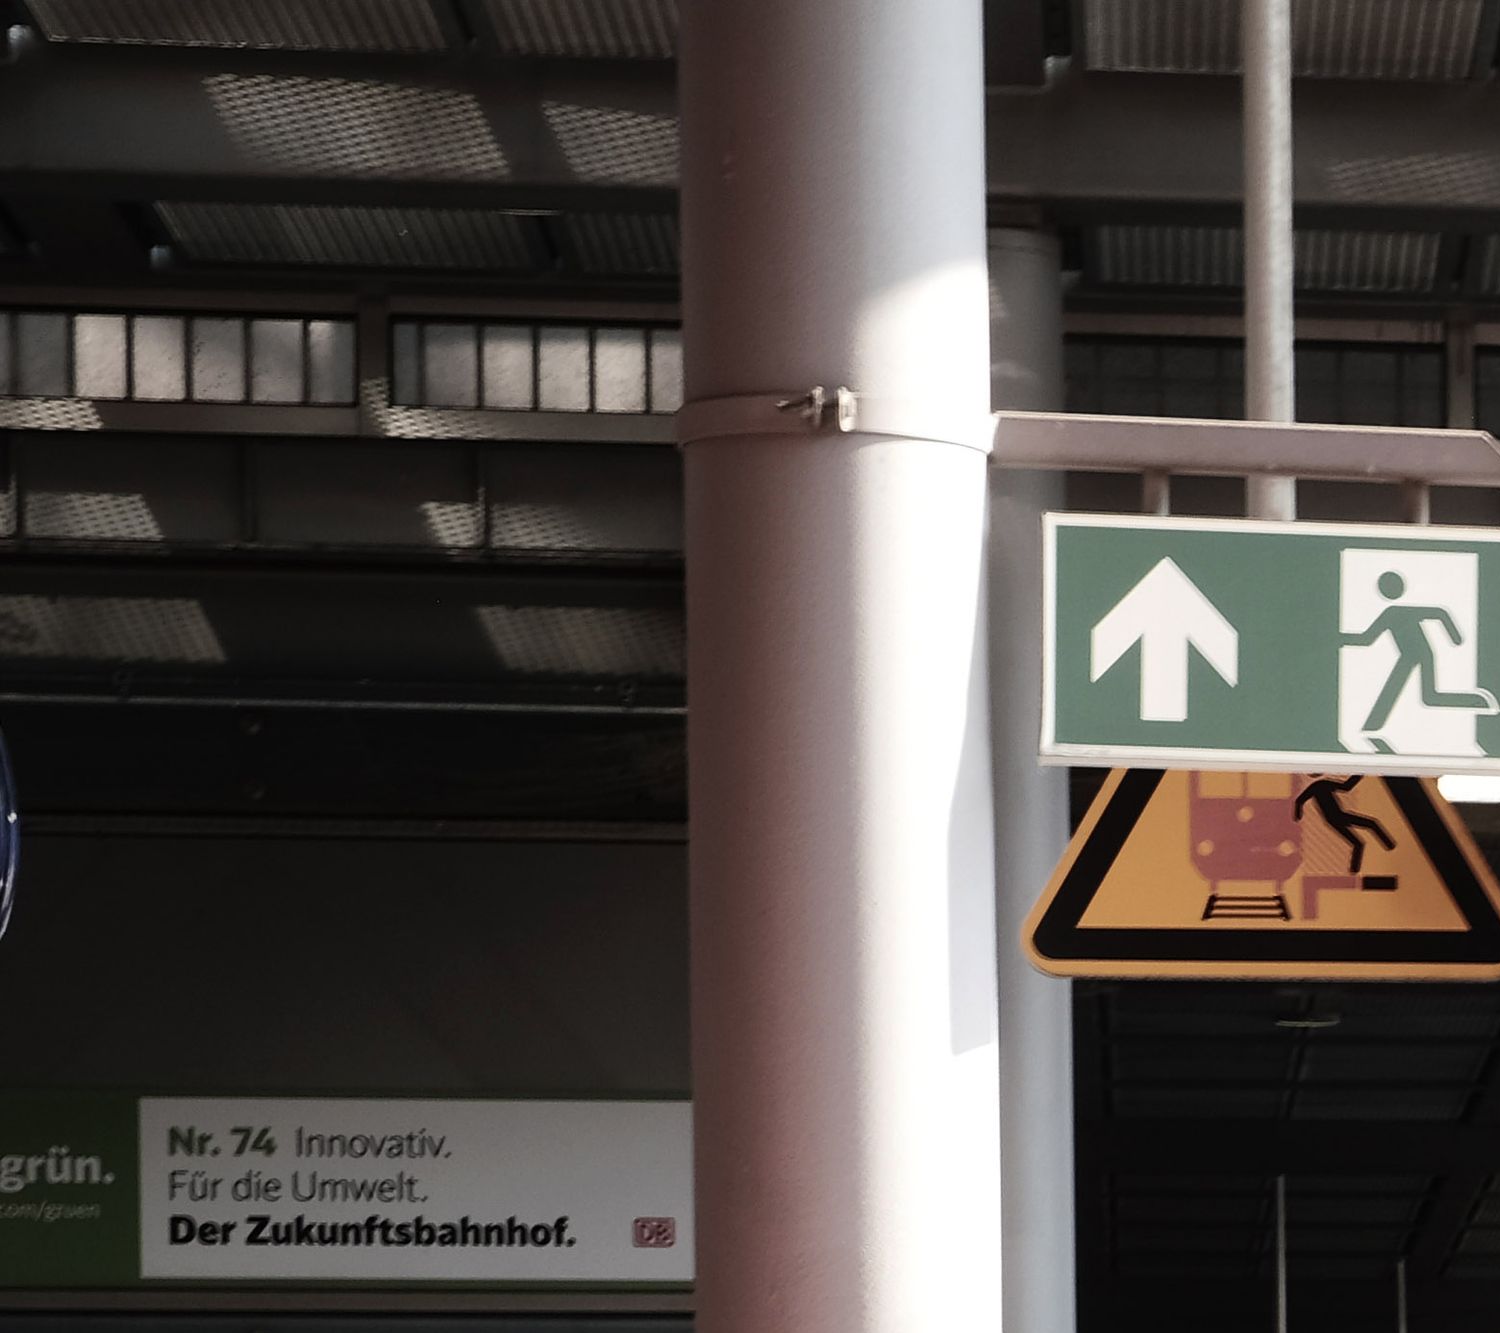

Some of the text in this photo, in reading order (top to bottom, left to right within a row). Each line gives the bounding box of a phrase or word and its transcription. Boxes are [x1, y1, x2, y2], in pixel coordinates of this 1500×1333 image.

[168, 1126, 452, 1159] Nr. 74 Innovativ.
[0, 1145, 115, 1193] grün.
[168, 1170, 429, 1203] Für die Umwelt.
[169, 1215, 577, 1248] Der Zukunftsbahnhof.
